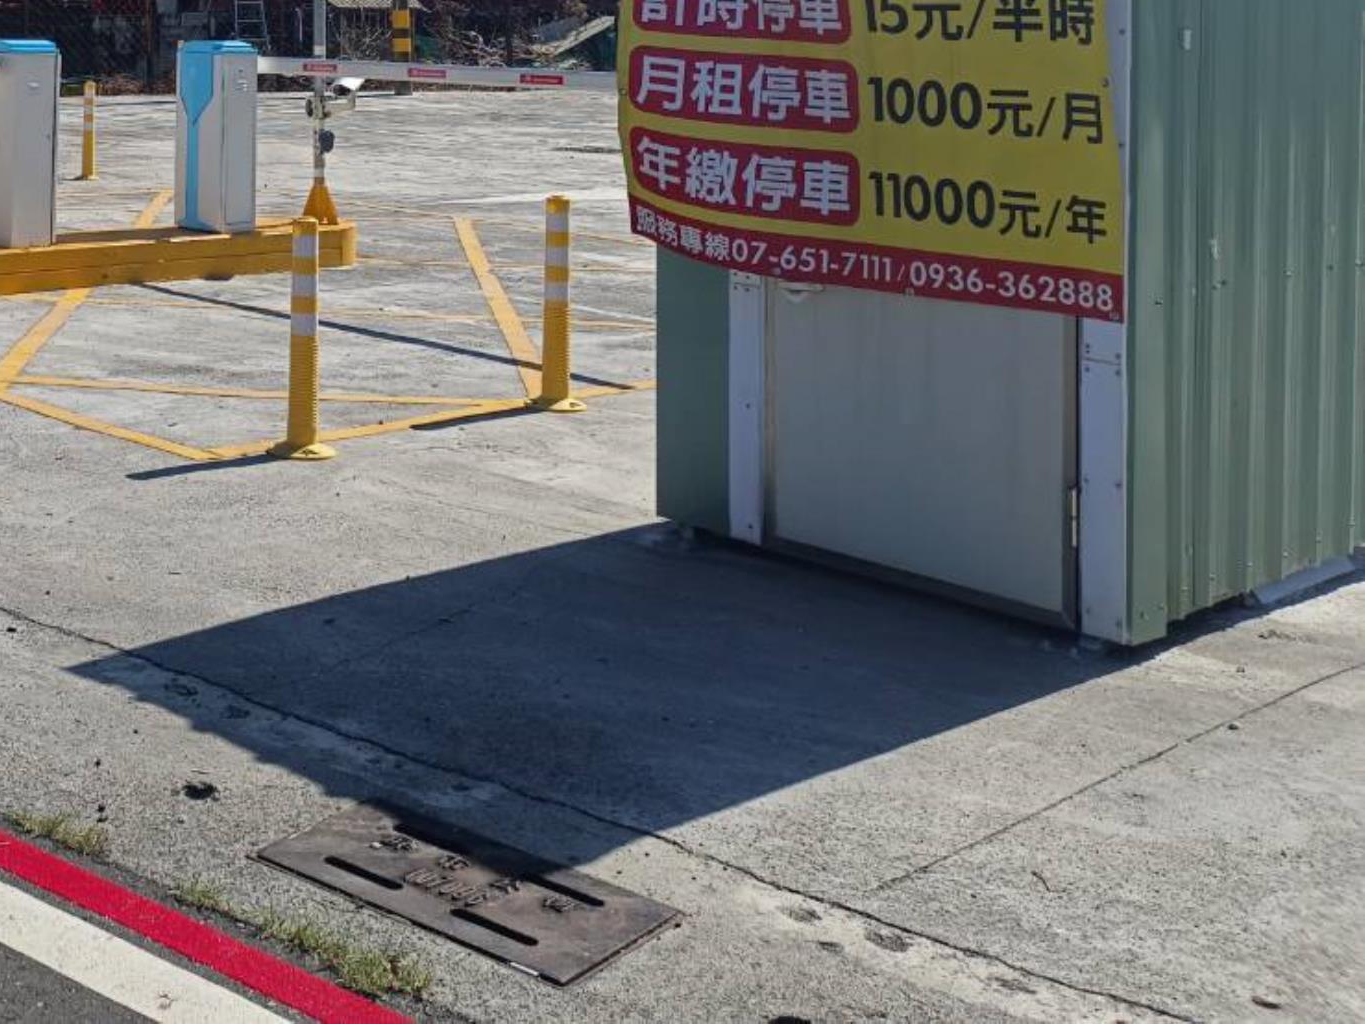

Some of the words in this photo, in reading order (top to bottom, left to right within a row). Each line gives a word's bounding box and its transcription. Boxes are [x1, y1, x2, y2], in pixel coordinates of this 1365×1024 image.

[636, 55, 852, 125] 月租停車
[869, 78, 1103, 144] 1000元/月
[636, 137, 852, 216] 年繳停車
[868, 170, 1108, 244] 11000元/年
